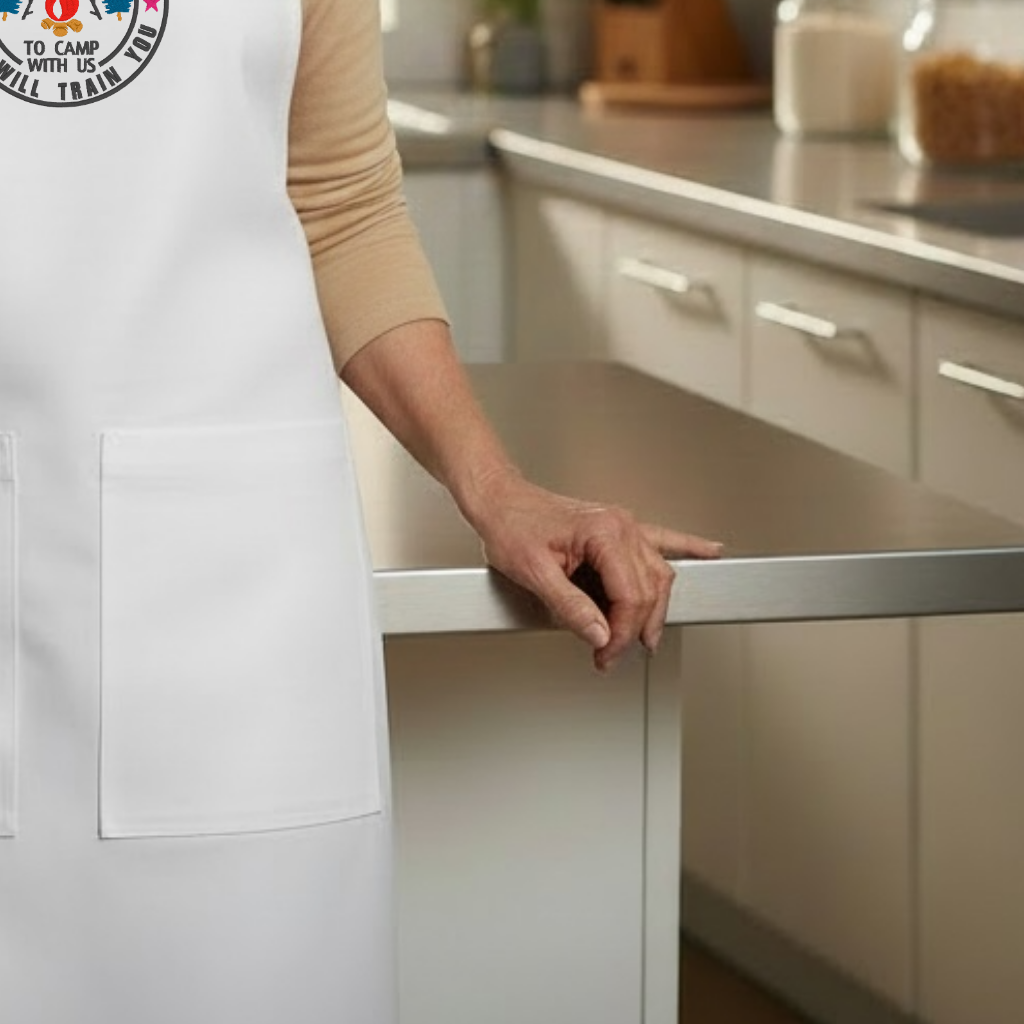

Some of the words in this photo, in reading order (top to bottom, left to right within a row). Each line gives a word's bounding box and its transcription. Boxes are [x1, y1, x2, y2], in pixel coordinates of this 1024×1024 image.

[23, 40, 45, 56] TO
[54, 40, 100, 56] CAMP
[27, 57, 68, 73] WITH
[76, 57, 97, 73] US
[57, 65, 122, 101] TRAIN
[123, 24, 157, 63] YOU
